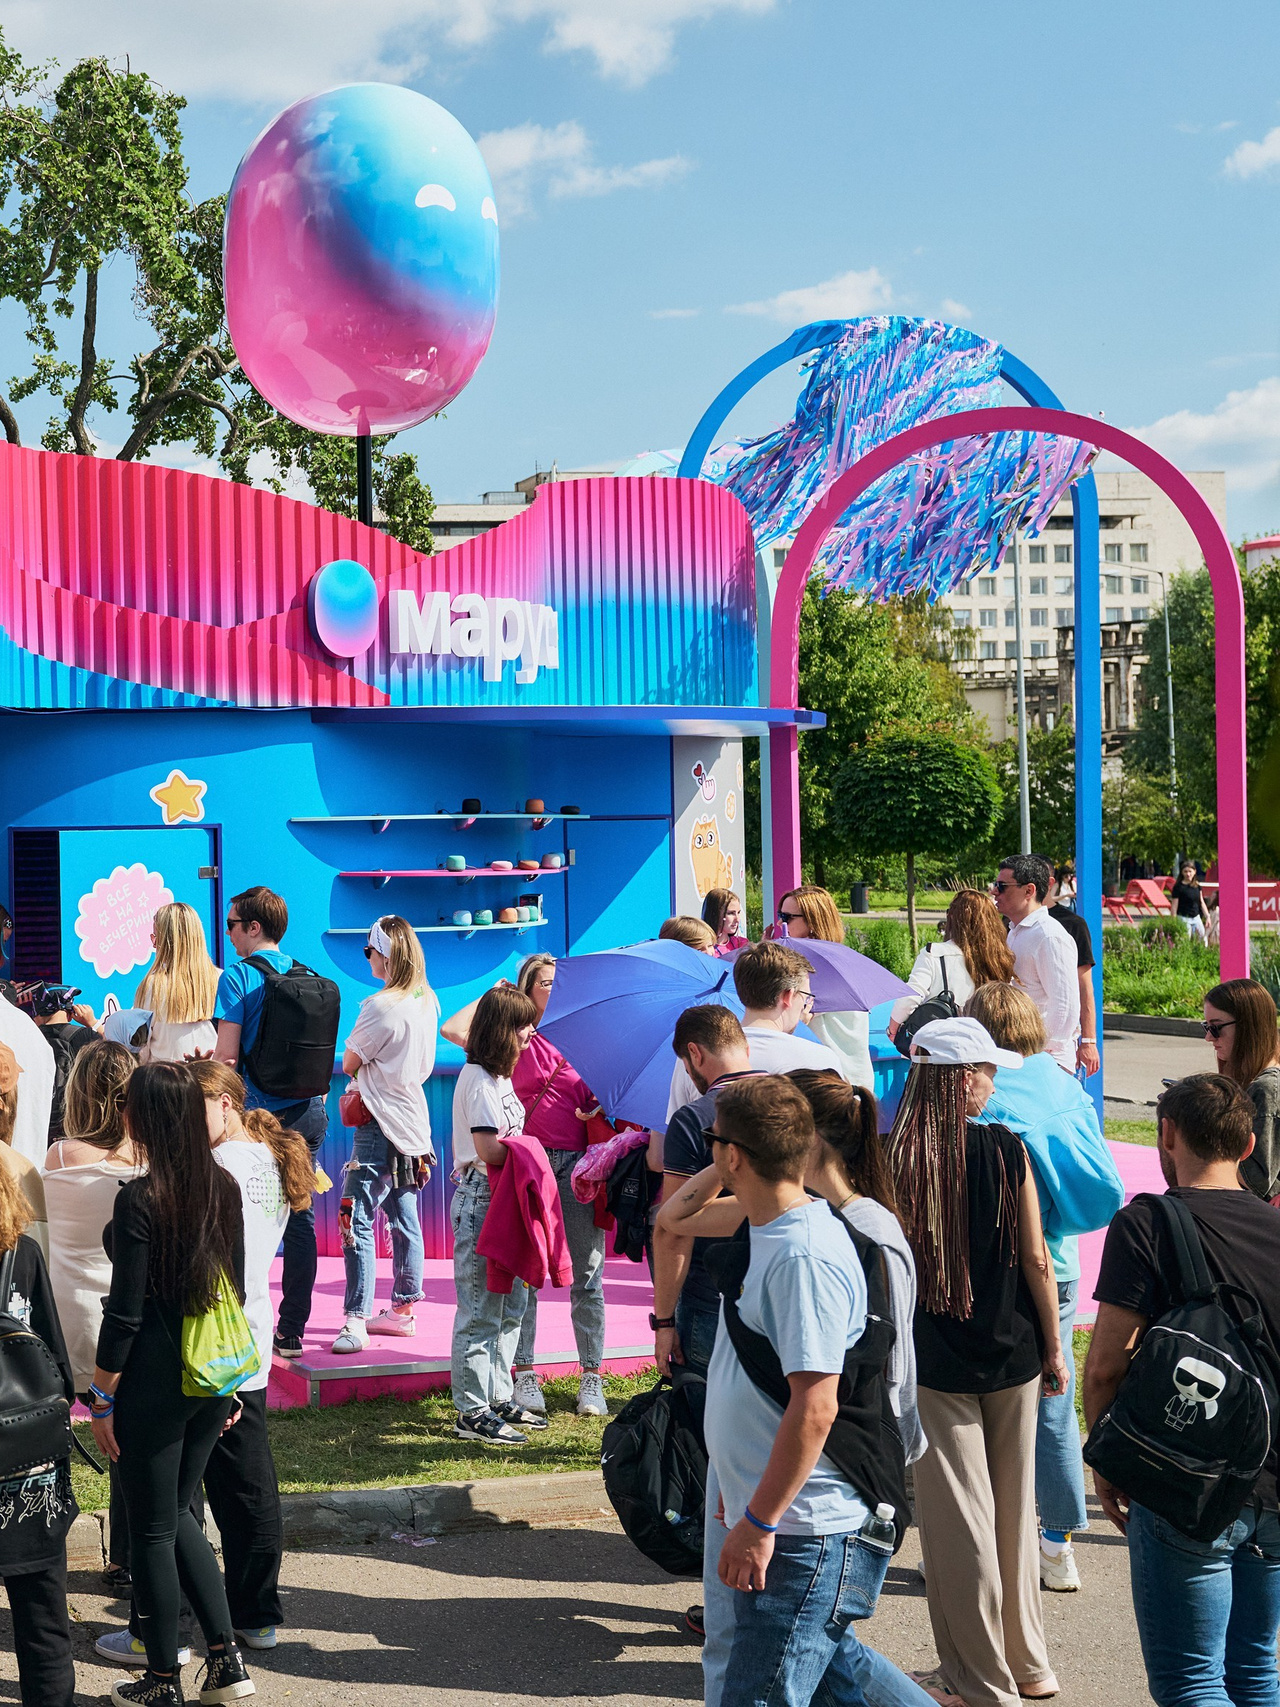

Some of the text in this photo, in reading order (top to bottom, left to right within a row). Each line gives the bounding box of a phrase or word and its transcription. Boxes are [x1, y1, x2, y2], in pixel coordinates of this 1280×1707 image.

[106, 883, 132, 907] ВСЕ
[115, 902, 134, 921] НА
[99, 905, 158, 955] ВЕЧЕРИНК
